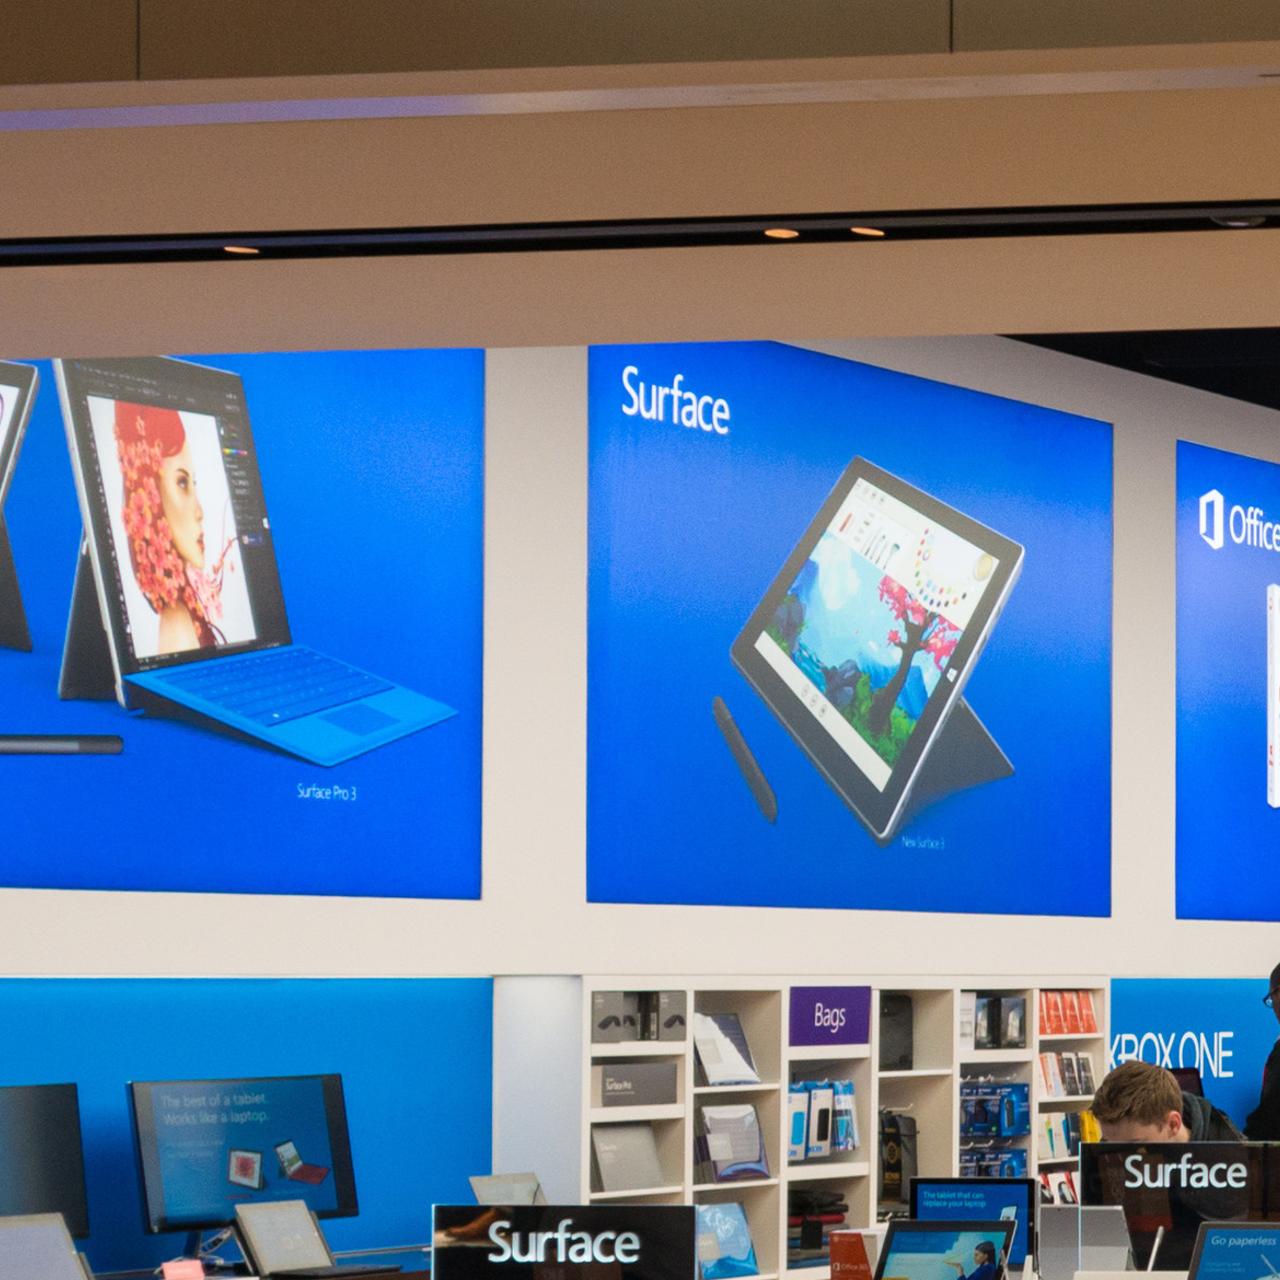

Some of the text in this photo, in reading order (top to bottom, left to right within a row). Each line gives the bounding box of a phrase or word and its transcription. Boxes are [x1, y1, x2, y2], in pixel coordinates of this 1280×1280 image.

[621, 365, 731, 435] Surface
[297, 783, 357, 801] Surface Pro 3
[814, 1002, 846, 1033] Bags
[1179, 1031, 1233, 1077] ONE
[162, 1096, 179, 1107] The
[184, 1095, 205, 1106] best
[209, 1094, 221, 1106] of
[164, 1113, 196, 1125] Works
[201, 1113, 217, 1124] like
[1124, 1153, 1248, 1188] Surface
[923, 1200, 947, 1208] replace
[964, 1200, 986, 1208] laptop
[924, 1191, 936, 1199] The
[937, 1191, 956, 1199] tablet
[957, 1191, 971, 1199] that
[487, 1218, 641, 1263] Surface
[1211, 1235, 1277, 1248] Go paperless
